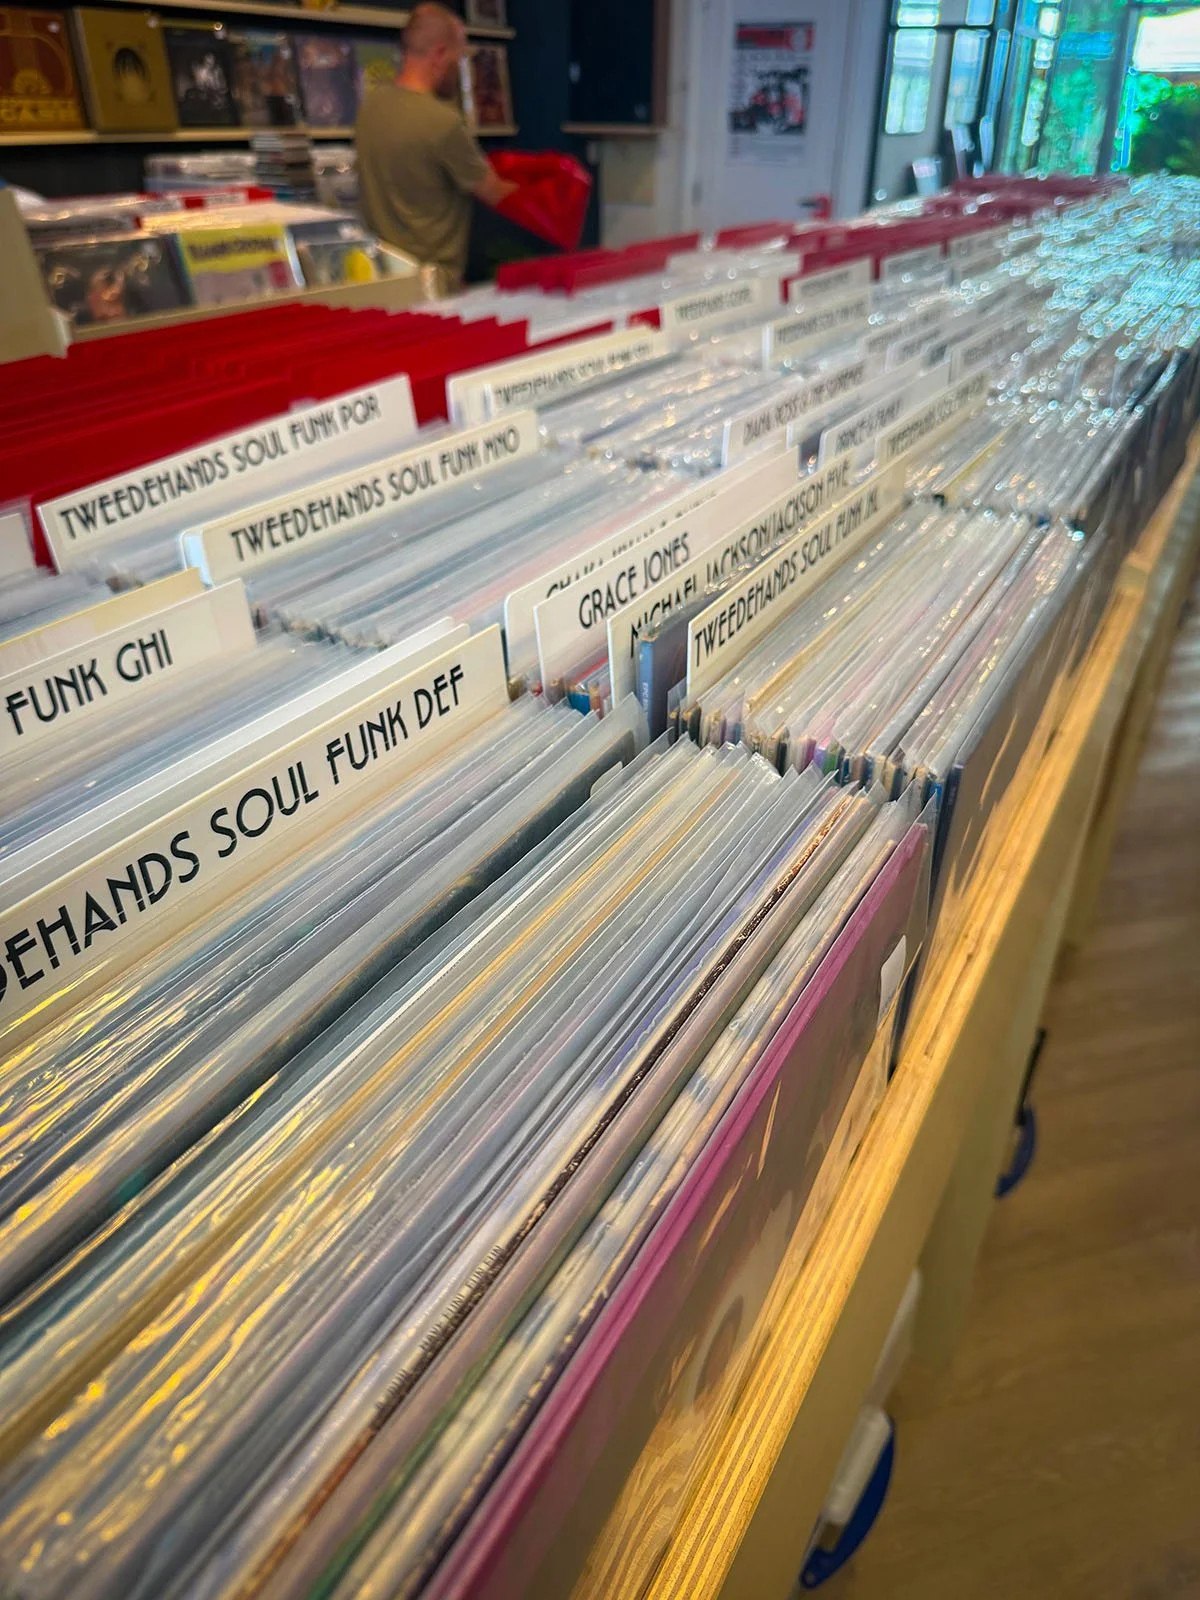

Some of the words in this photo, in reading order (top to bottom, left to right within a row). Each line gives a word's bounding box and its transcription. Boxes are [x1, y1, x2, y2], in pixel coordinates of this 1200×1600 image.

[60, 451, 229, 541] TWEEDEHANDS
[232, 431, 288, 472] SOUL
[289, 409, 342, 450] FUNK
[231, 478, 385, 561] TWEEDEHANDS
[387, 459, 437, 502] SOUL
[439, 445, 484, 482] FUNK
[826, 459, 850, 498] FIVE
[578, 565, 637, 629] GRACE
[643, 532, 690, 589] JONES
[695, 551, 798, 668] TWEEDEHANDS
[800, 524, 831, 575] SOUL
[835, 497, 863, 546] FUNK
[5, 658, 107, 735] FUNK
[115, 629, 174, 683] GHI
[0, 830, 200, 1000] EHANDS
[210, 761, 319, 858] SOUL
[326, 701, 408, 785] FUNK
[413, 664, 464, 728] DEF
